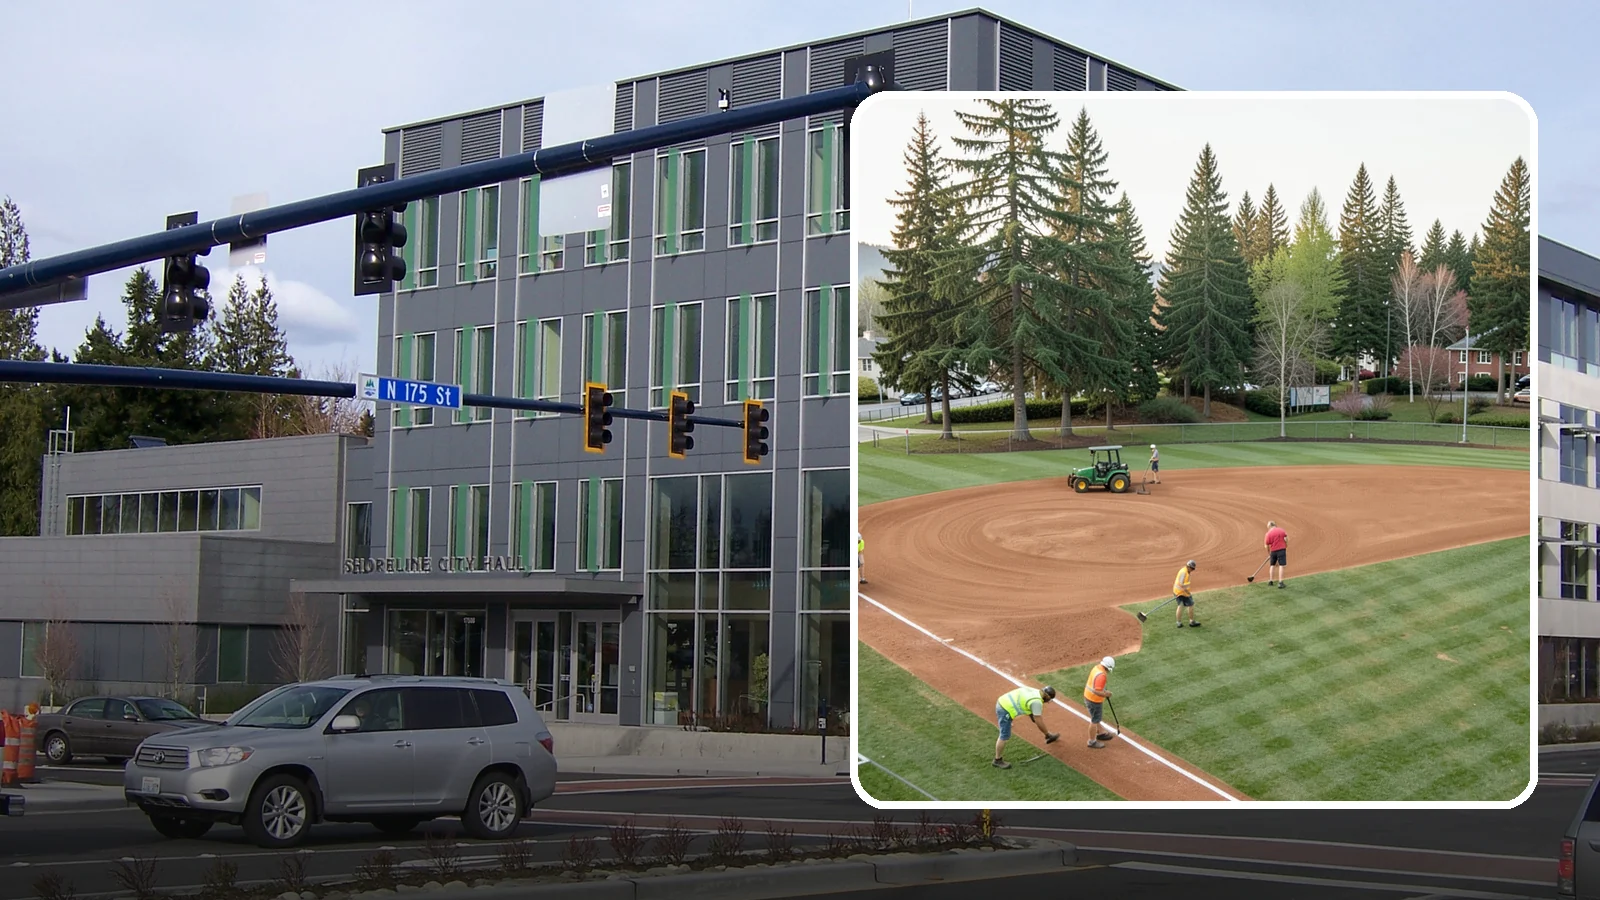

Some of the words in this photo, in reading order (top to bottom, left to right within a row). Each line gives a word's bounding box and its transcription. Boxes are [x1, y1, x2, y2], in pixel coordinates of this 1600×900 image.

[387, 380, 396, 400] N
[405, 382, 428, 403] 175
[436, 386, 452, 406] St
[343, 557, 432, 574] SHORELINE
[438, 555, 476, 573] CITY
[484, 555, 525, 572] HALL
